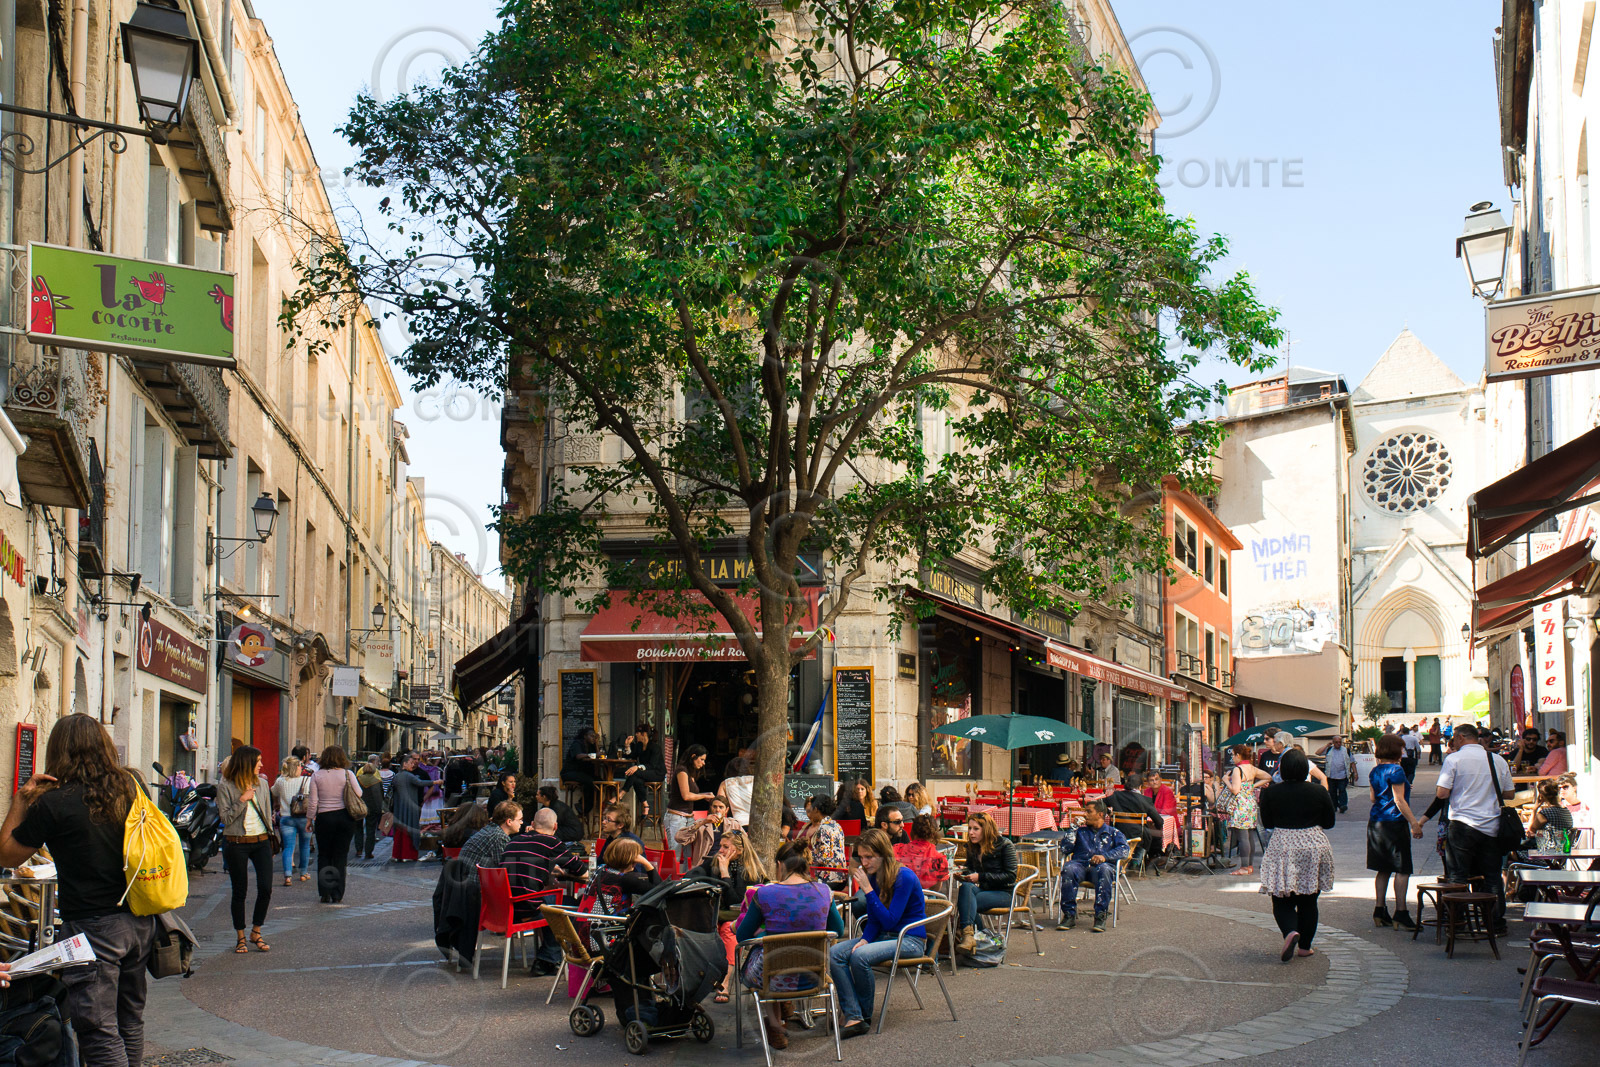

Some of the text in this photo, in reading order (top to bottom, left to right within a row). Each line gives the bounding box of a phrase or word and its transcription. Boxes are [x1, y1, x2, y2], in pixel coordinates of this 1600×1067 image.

[1528, 310, 1554, 326] The
[1505, 352, 1577, 370] Restaurant
[1579, 350, 1590, 360] &
[1252, 533, 1310, 562] MDMA
[710, 559, 729, 578] LA
[944, 576, 950, 595] DE
[637, 648, 694, 660] BOUCHON
[1090, 664, 1105, 678] MAISON
[1542, 696, 1562, 704] Pub
